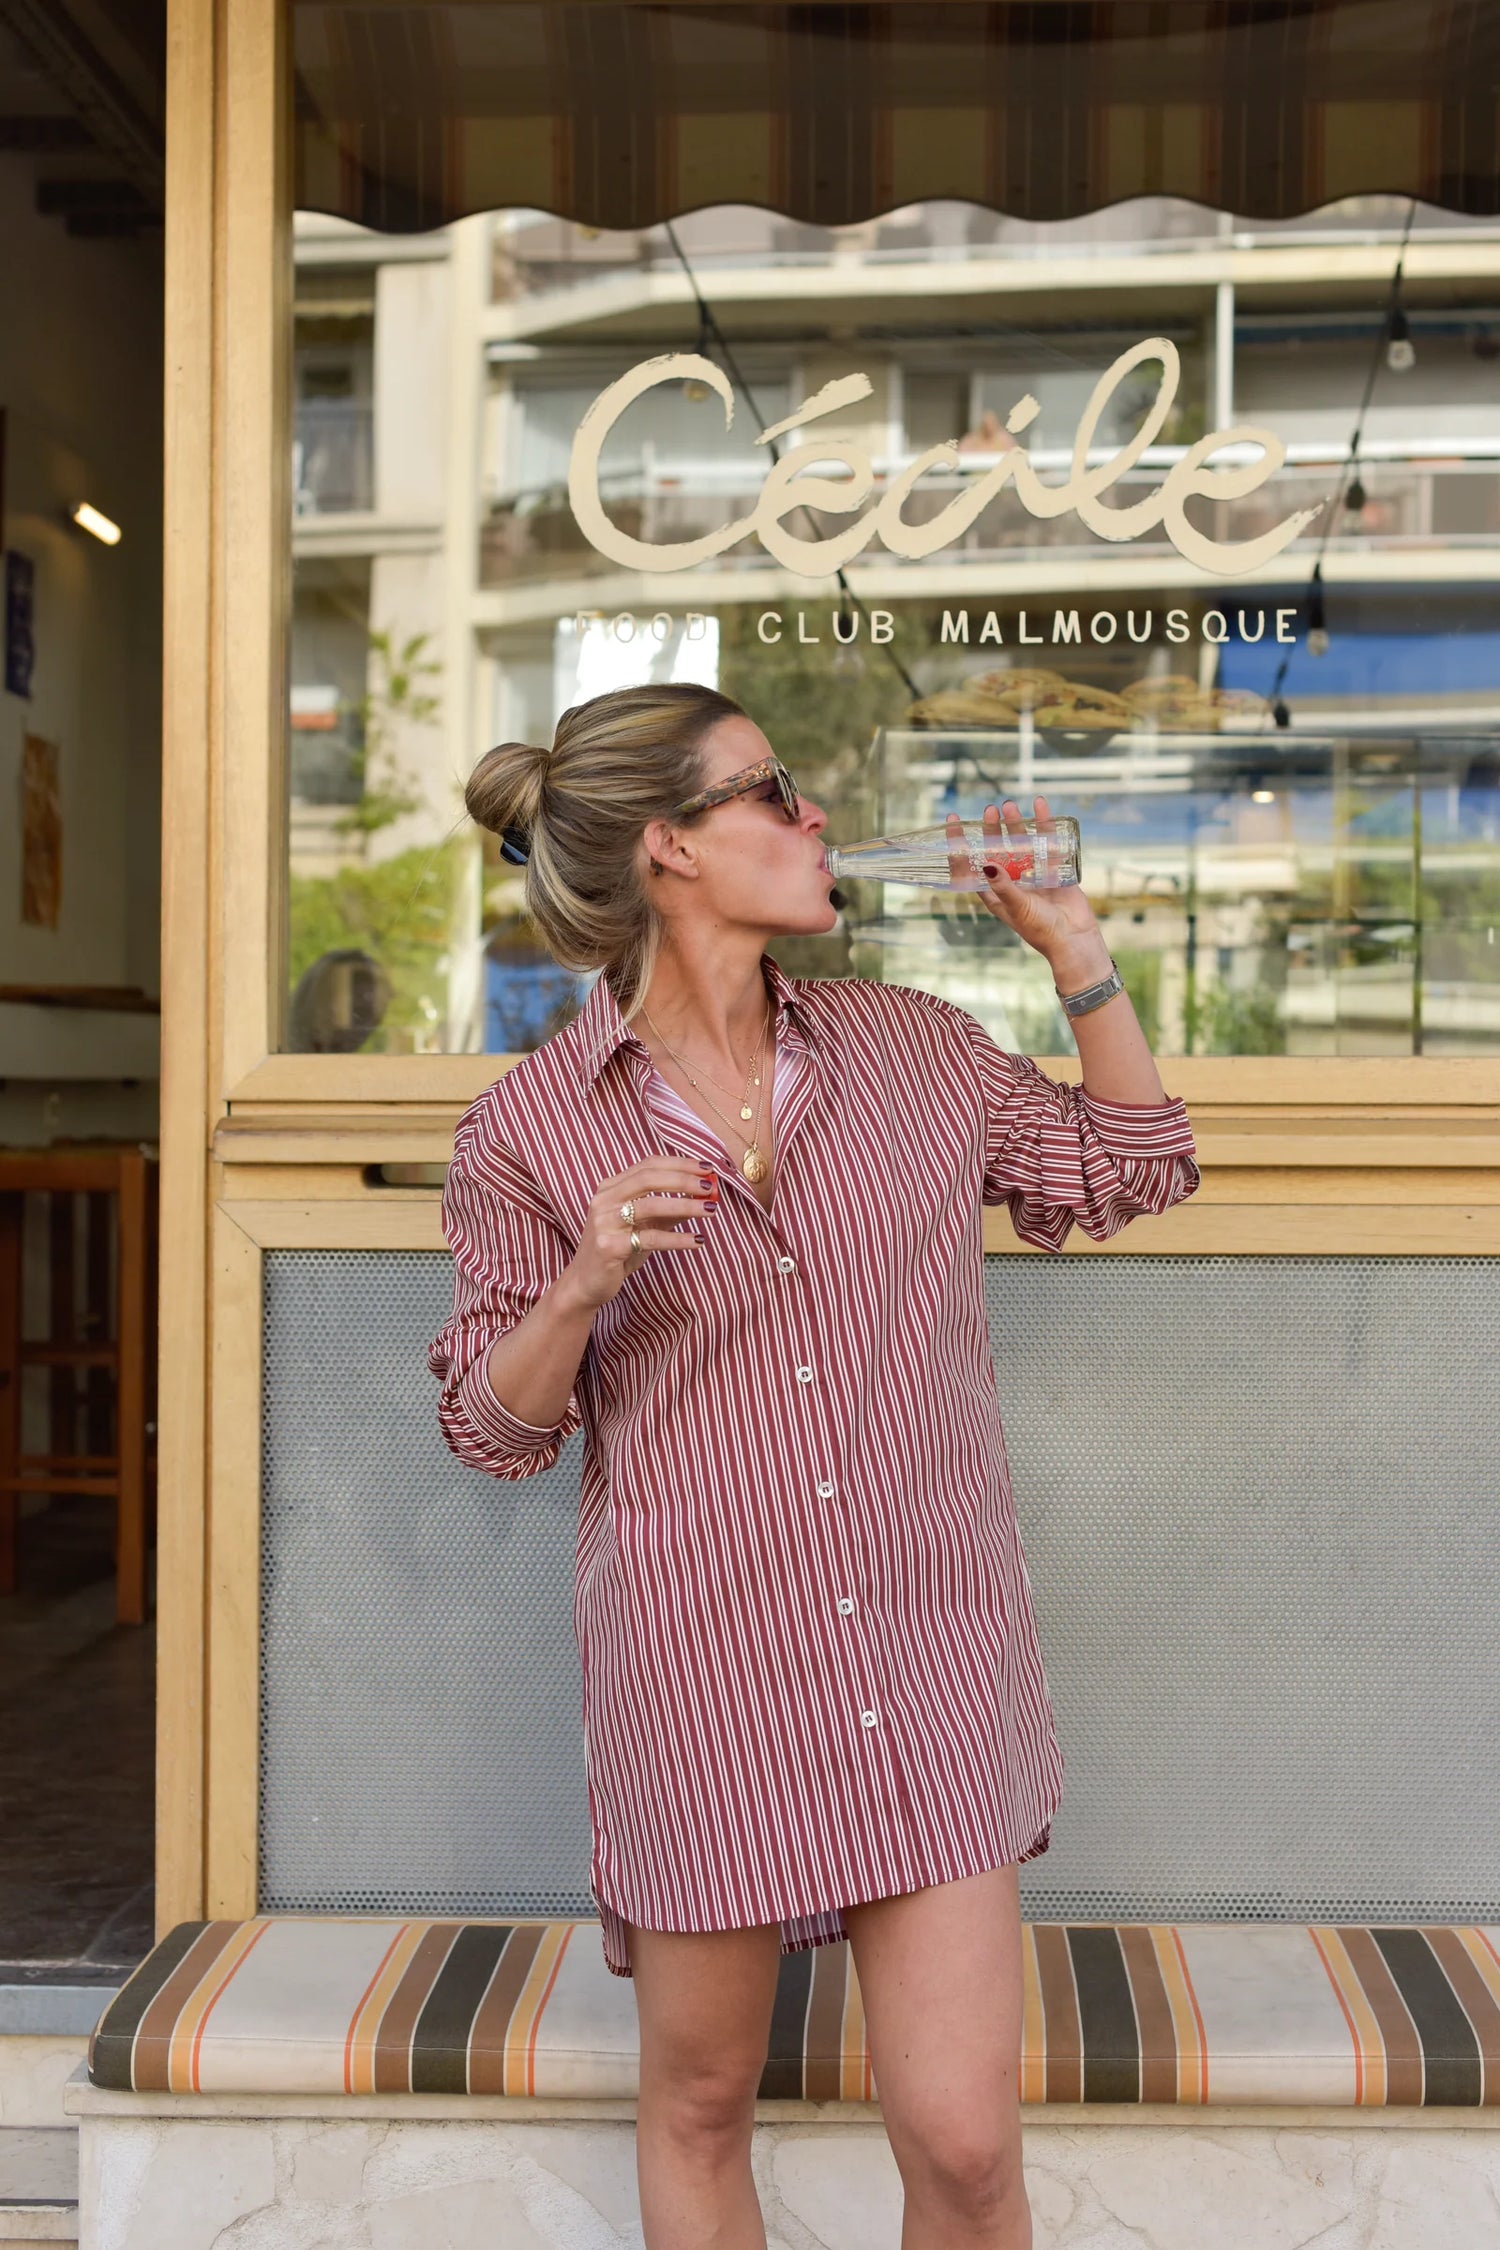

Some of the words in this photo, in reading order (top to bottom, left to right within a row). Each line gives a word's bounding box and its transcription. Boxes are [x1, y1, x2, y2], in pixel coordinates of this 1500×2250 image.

[568, 337, 1325, 578] Cécile
[574, 610, 707, 644] FOOD
[757, 610, 895, 645] CLUB
[940, 608, 1299, 645] MALMOUSQUE
